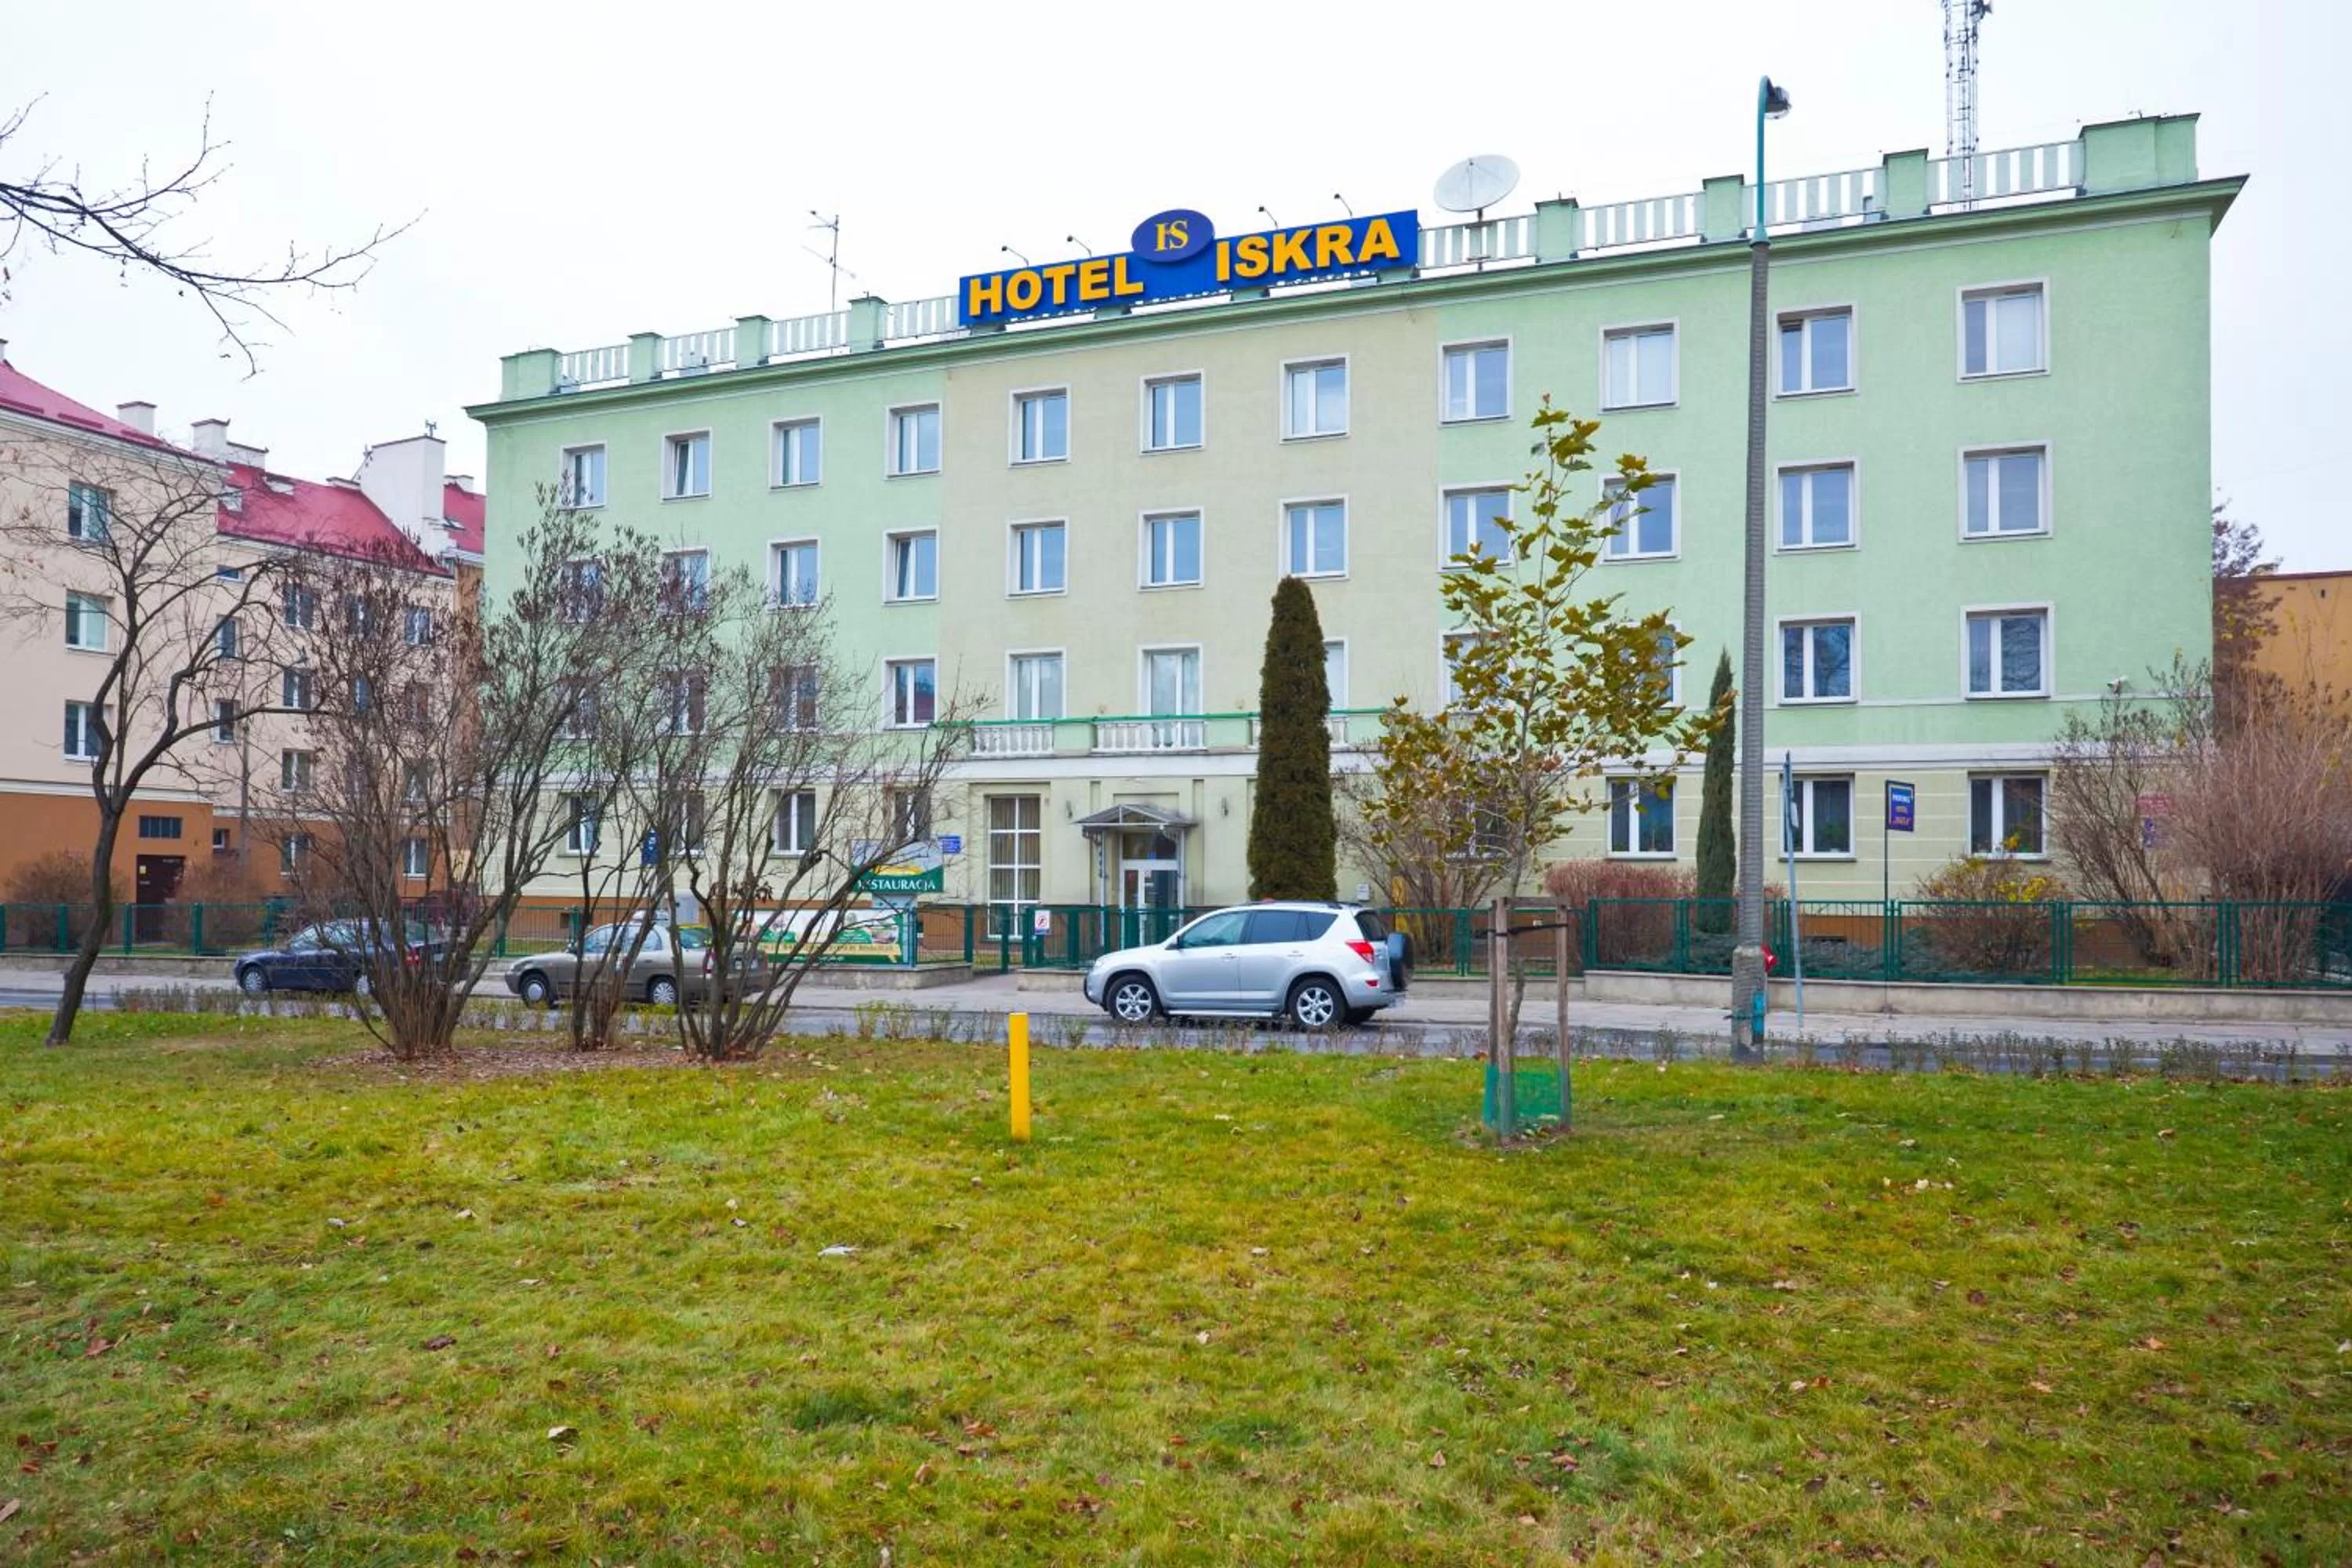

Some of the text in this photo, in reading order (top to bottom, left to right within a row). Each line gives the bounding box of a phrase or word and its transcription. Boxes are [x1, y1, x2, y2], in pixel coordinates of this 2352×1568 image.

[968, 218, 1399, 316] HOTEL ISKRA
[858, 879, 936, 891] STAURACJA
